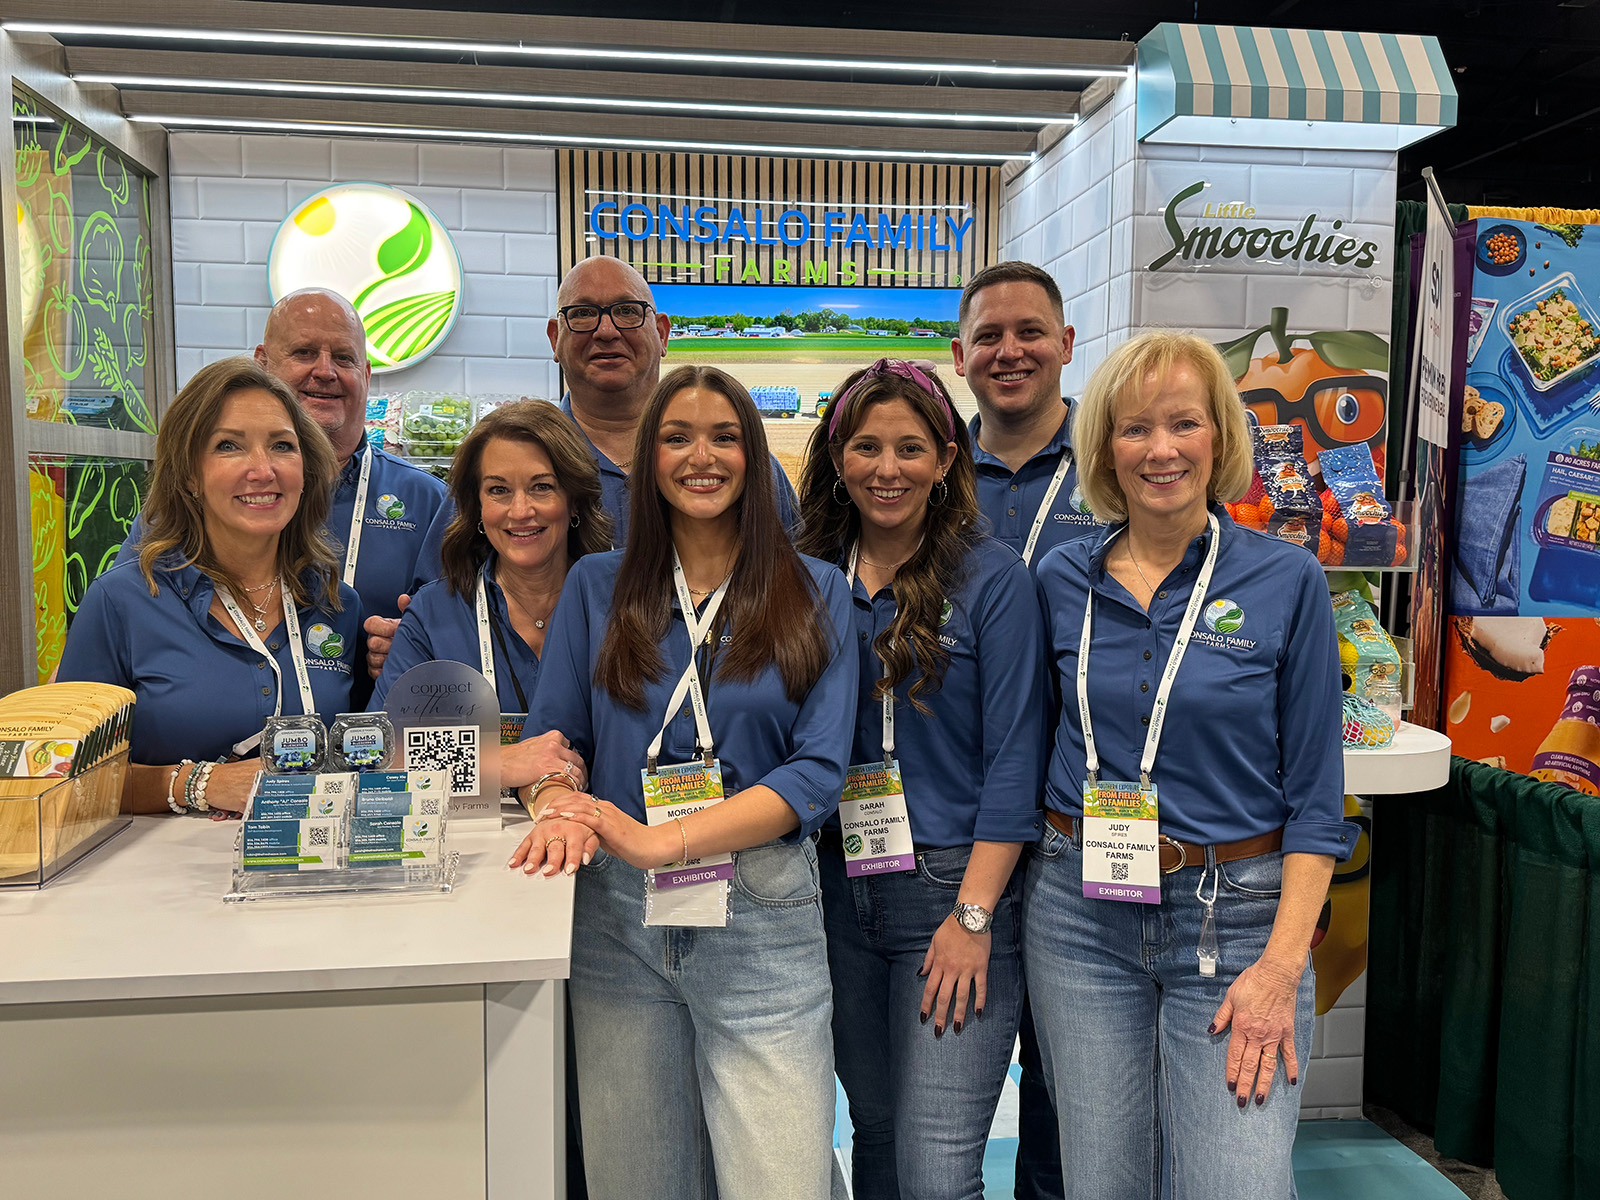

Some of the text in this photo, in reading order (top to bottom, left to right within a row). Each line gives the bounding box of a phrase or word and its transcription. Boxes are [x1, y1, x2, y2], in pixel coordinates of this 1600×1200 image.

[1203, 202, 1256, 219] Little
[590, 201, 974, 252] CONSALO FAMILY
[1148, 180, 1379, 272] Smoochies
[715, 257, 858, 286] FARMS
[1572, 457, 1591, 468] ACRES
[1552, 467, 1594, 481] HAIL, CAESAR!
[365, 517, 417, 529] CONSALO FAMILY
[1054, 513, 1090, 522] CONSALO
[939, 634, 958, 647] MILY
[1190, 631, 1257, 649] ONSALO FAMILY
[1205, 641, 1231, 650] FARMS
[304, 658, 335, 667] ONSALO
[411, 682, 472, 694] connect
[401, 691, 481, 722] with us
[1564, 755, 1589, 768] INGREDIENTS
[848, 774, 866, 782] FROM
[866, 771, 886, 780] FIELDS
[1572, 764, 1591, 777] ANYTHING
[660, 773, 705, 786] FROM FIELDS
[858, 778, 888, 788] FAMILIES
[662, 781, 706, 793] TO FAMILIES
[1098, 790, 1141, 800] FROM FIELDS
[462, 802, 489, 810] Farms
[859, 802, 885, 811] SARAH
[1108, 799, 1141, 808] FAMILIES
[667, 806, 705, 817] MORGAN
[844, 815, 906, 830] CONSALO FAMILY
[1108, 824, 1130, 832] JUDY
[864, 827, 889, 836] FARMS
[1085, 840, 1156, 852] CONSALO FAMILY
[1105, 852, 1134, 860] FARMS
[861, 860, 901, 871] EXHIBITOR
[672, 871, 717, 884] EXHIBITOR
[1099, 887, 1143, 898] EXHIBITOR
